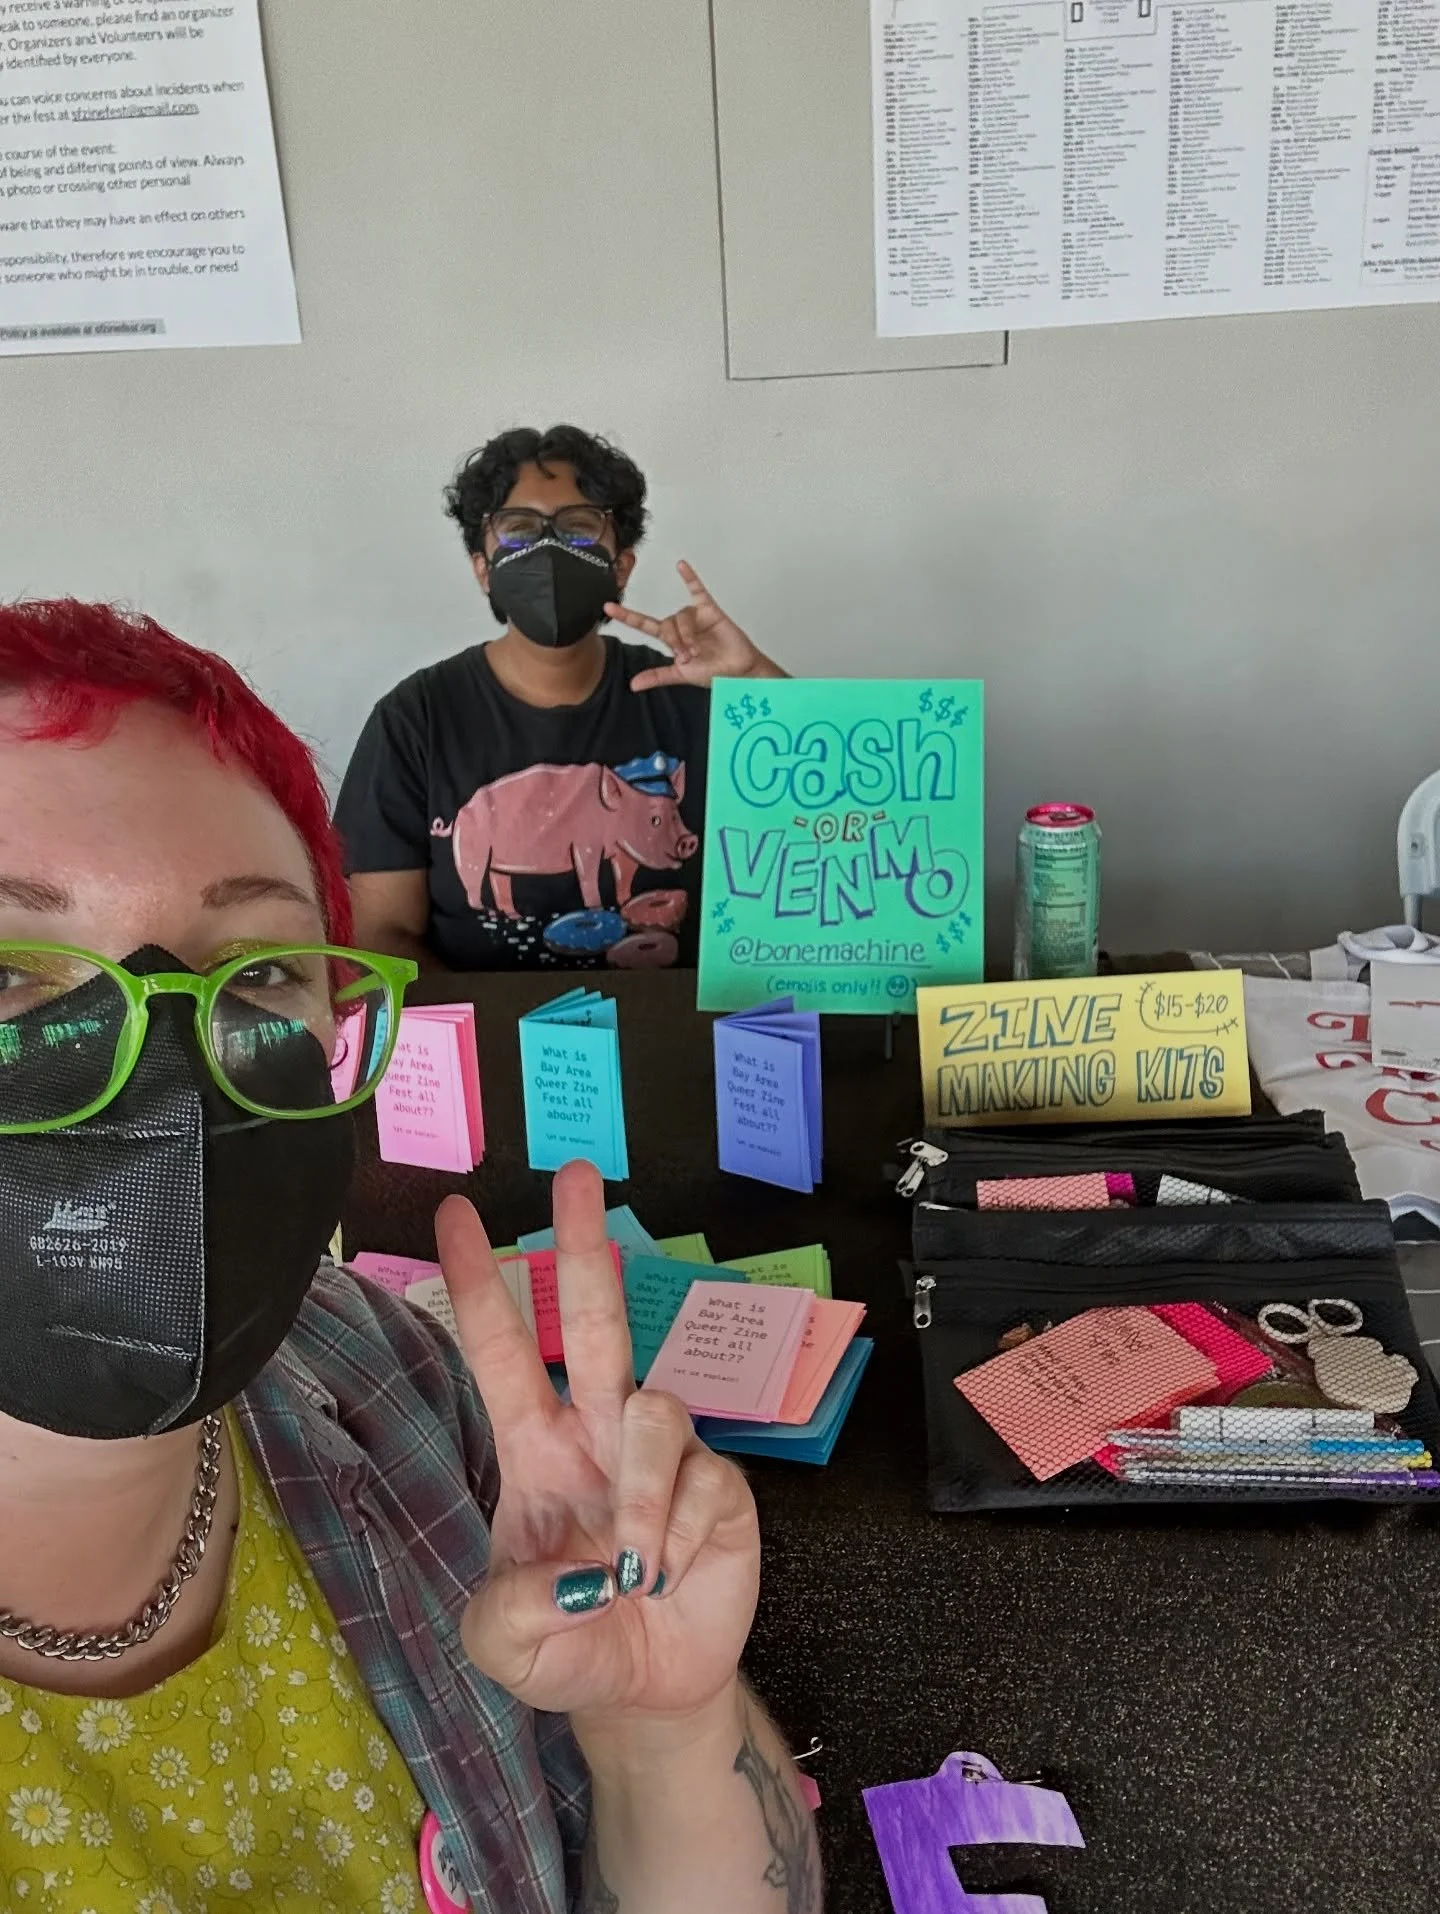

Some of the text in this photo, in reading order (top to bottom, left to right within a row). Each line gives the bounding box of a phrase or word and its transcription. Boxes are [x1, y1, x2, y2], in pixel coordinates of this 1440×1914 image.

[22, 20, 35, 31] to
[95, 12, 133, 27] please
[135, 9, 158, 23] find
[161, 10, 177, 21] an
[178, 7, 235, 22] organizer
[7, 36, 72, 52] Organizers
[75, 34, 97, 46] and
[98, 30, 163, 44] Volunteers
[165, 26, 187, 39] will
[188, 26, 204, 39] be
[6, 53, 62, 70] identified
[63, 52, 78, 68] by
[10, 95, 31, 106] can
[32, 91, 61, 104] voice
[64, 88, 119, 102] concerns
[120, 84, 153, 99] about
[155, 81, 211, 97] incidents
[212, 79, 245, 93] when
[12, 110, 31, 124] the
[33, 107, 56, 122] fest
[58, 108, 69, 121] at
[5, 149, 43, 161] course
[45, 145, 57, 159] of
[59, 143, 78, 157] the
[9, 164, 42, 179] being
[44, 162, 65, 176] and
[66, 160, 116, 175] differing
[118, 158, 154, 173] points
[155, 157, 168, 170] of
[203, 154, 245, 168] Always
[7, 184, 42, 198] photo
[43, 184, 55, 194] or
[58, 180, 106, 194] crossing
[107, 178, 137, 190] other
[139, 173, 191, 191] personal
[30, 217, 55, 231] that
[56, 215, 81, 231] they
[83, 215, 107, 229] may
[109, 212, 137, 226] have
[139, 213, 153, 225] an
[154, 208, 188, 224] effect
[191, 210, 207, 222] on
[208, 207, 246, 221] others
[71, 250, 126, 263] therefore
[127, 249, 145, 261] we
[146, 245, 207, 261] encourage
[208, 244, 231, 258] you
[232, 243, 246, 256] to
[4, 270, 57, 284] someone
[58, 267, 82, 281] who
[85, 265, 118, 282] might
[119, 264, 133, 278] be
[135, 264, 146, 277] in
[194, 263, 208, 275] or
[209, 260, 240, 274] need
[719, 815, 970, 928] VENMO
[729, 935, 927, 968] @bonemachine
[766, 974, 882, 997] (emojis only!!
[1153, 990, 1229, 1020] $15-$20
[939, 993, 1122, 1057] ZINE
[397, 1042, 429, 1056] at is
[542, 1045, 588, 1062] What is
[391, 1057, 434, 1072] ay Area
[541, 1060, 592, 1079] Bay Area
[734, 1051, 776, 1073] What is
[417, 1073, 440, 1088] Zine
[534, 1076, 599, 1096] Queer Zine
[732, 1065, 779, 1089] Bay Area
[937, 1043, 1225, 1117] MAKING KITS
[388, 1085, 436, 1103] Fest all
[542, 1092, 593, 1110] Fest all
[727, 1080, 785, 1107] Queer Zine
[393, 1102, 434, 1117] about??
[546, 1108, 591, 1125] about??
[733, 1098, 781, 1122] Fest all
[737, 1116, 777, 1134] about??
[30, 1235, 128, 1252] GB2626-2019
[36, 1254, 123, 1272] L-103V KN95
[708, 1296, 766, 1313] What is
[698, 1308, 725, 1321] Bay
[730, 1313, 765, 1326] Area
[684, 1320, 768, 1340] Queer Zine
[686, 1333, 753, 1352] Fest all
[683, 1347, 745, 1364] about??
